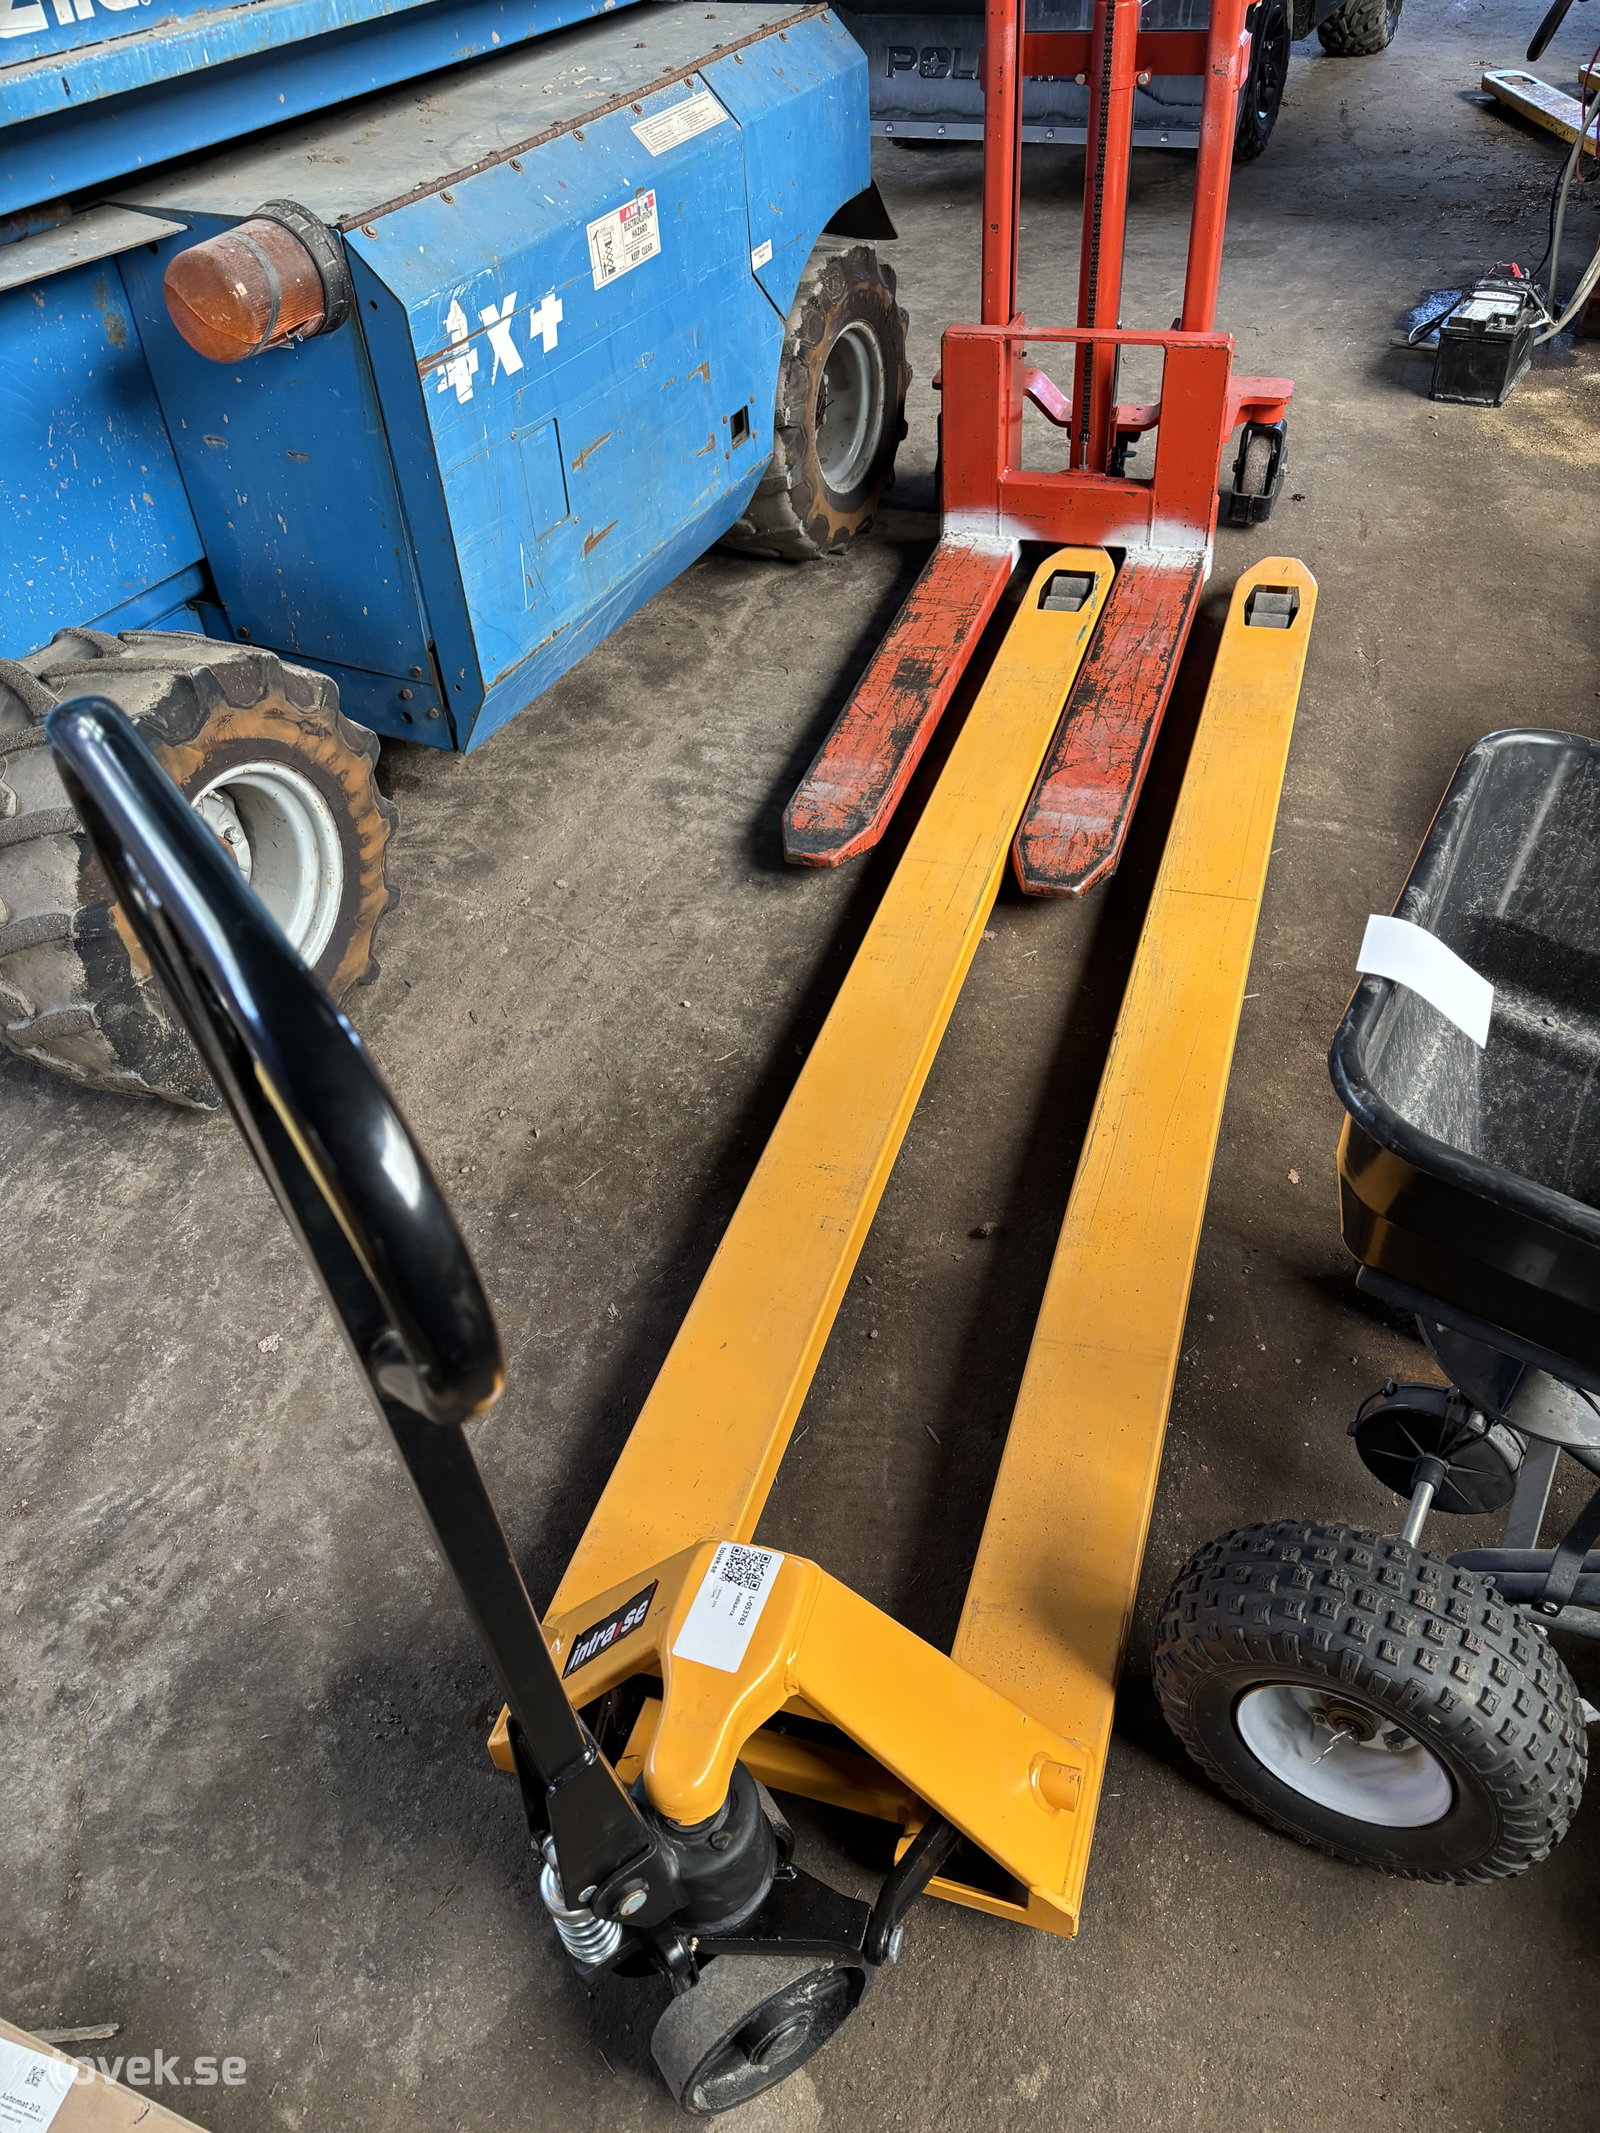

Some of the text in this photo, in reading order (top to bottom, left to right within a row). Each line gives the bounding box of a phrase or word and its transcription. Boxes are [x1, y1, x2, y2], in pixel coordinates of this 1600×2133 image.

[630, 249, 640, 262] KEEP
[641, 242, 653, 256] CLEAR
[710, 1546, 727, 1574] tovek.se
[737, 1595, 756, 1626] L-053763
